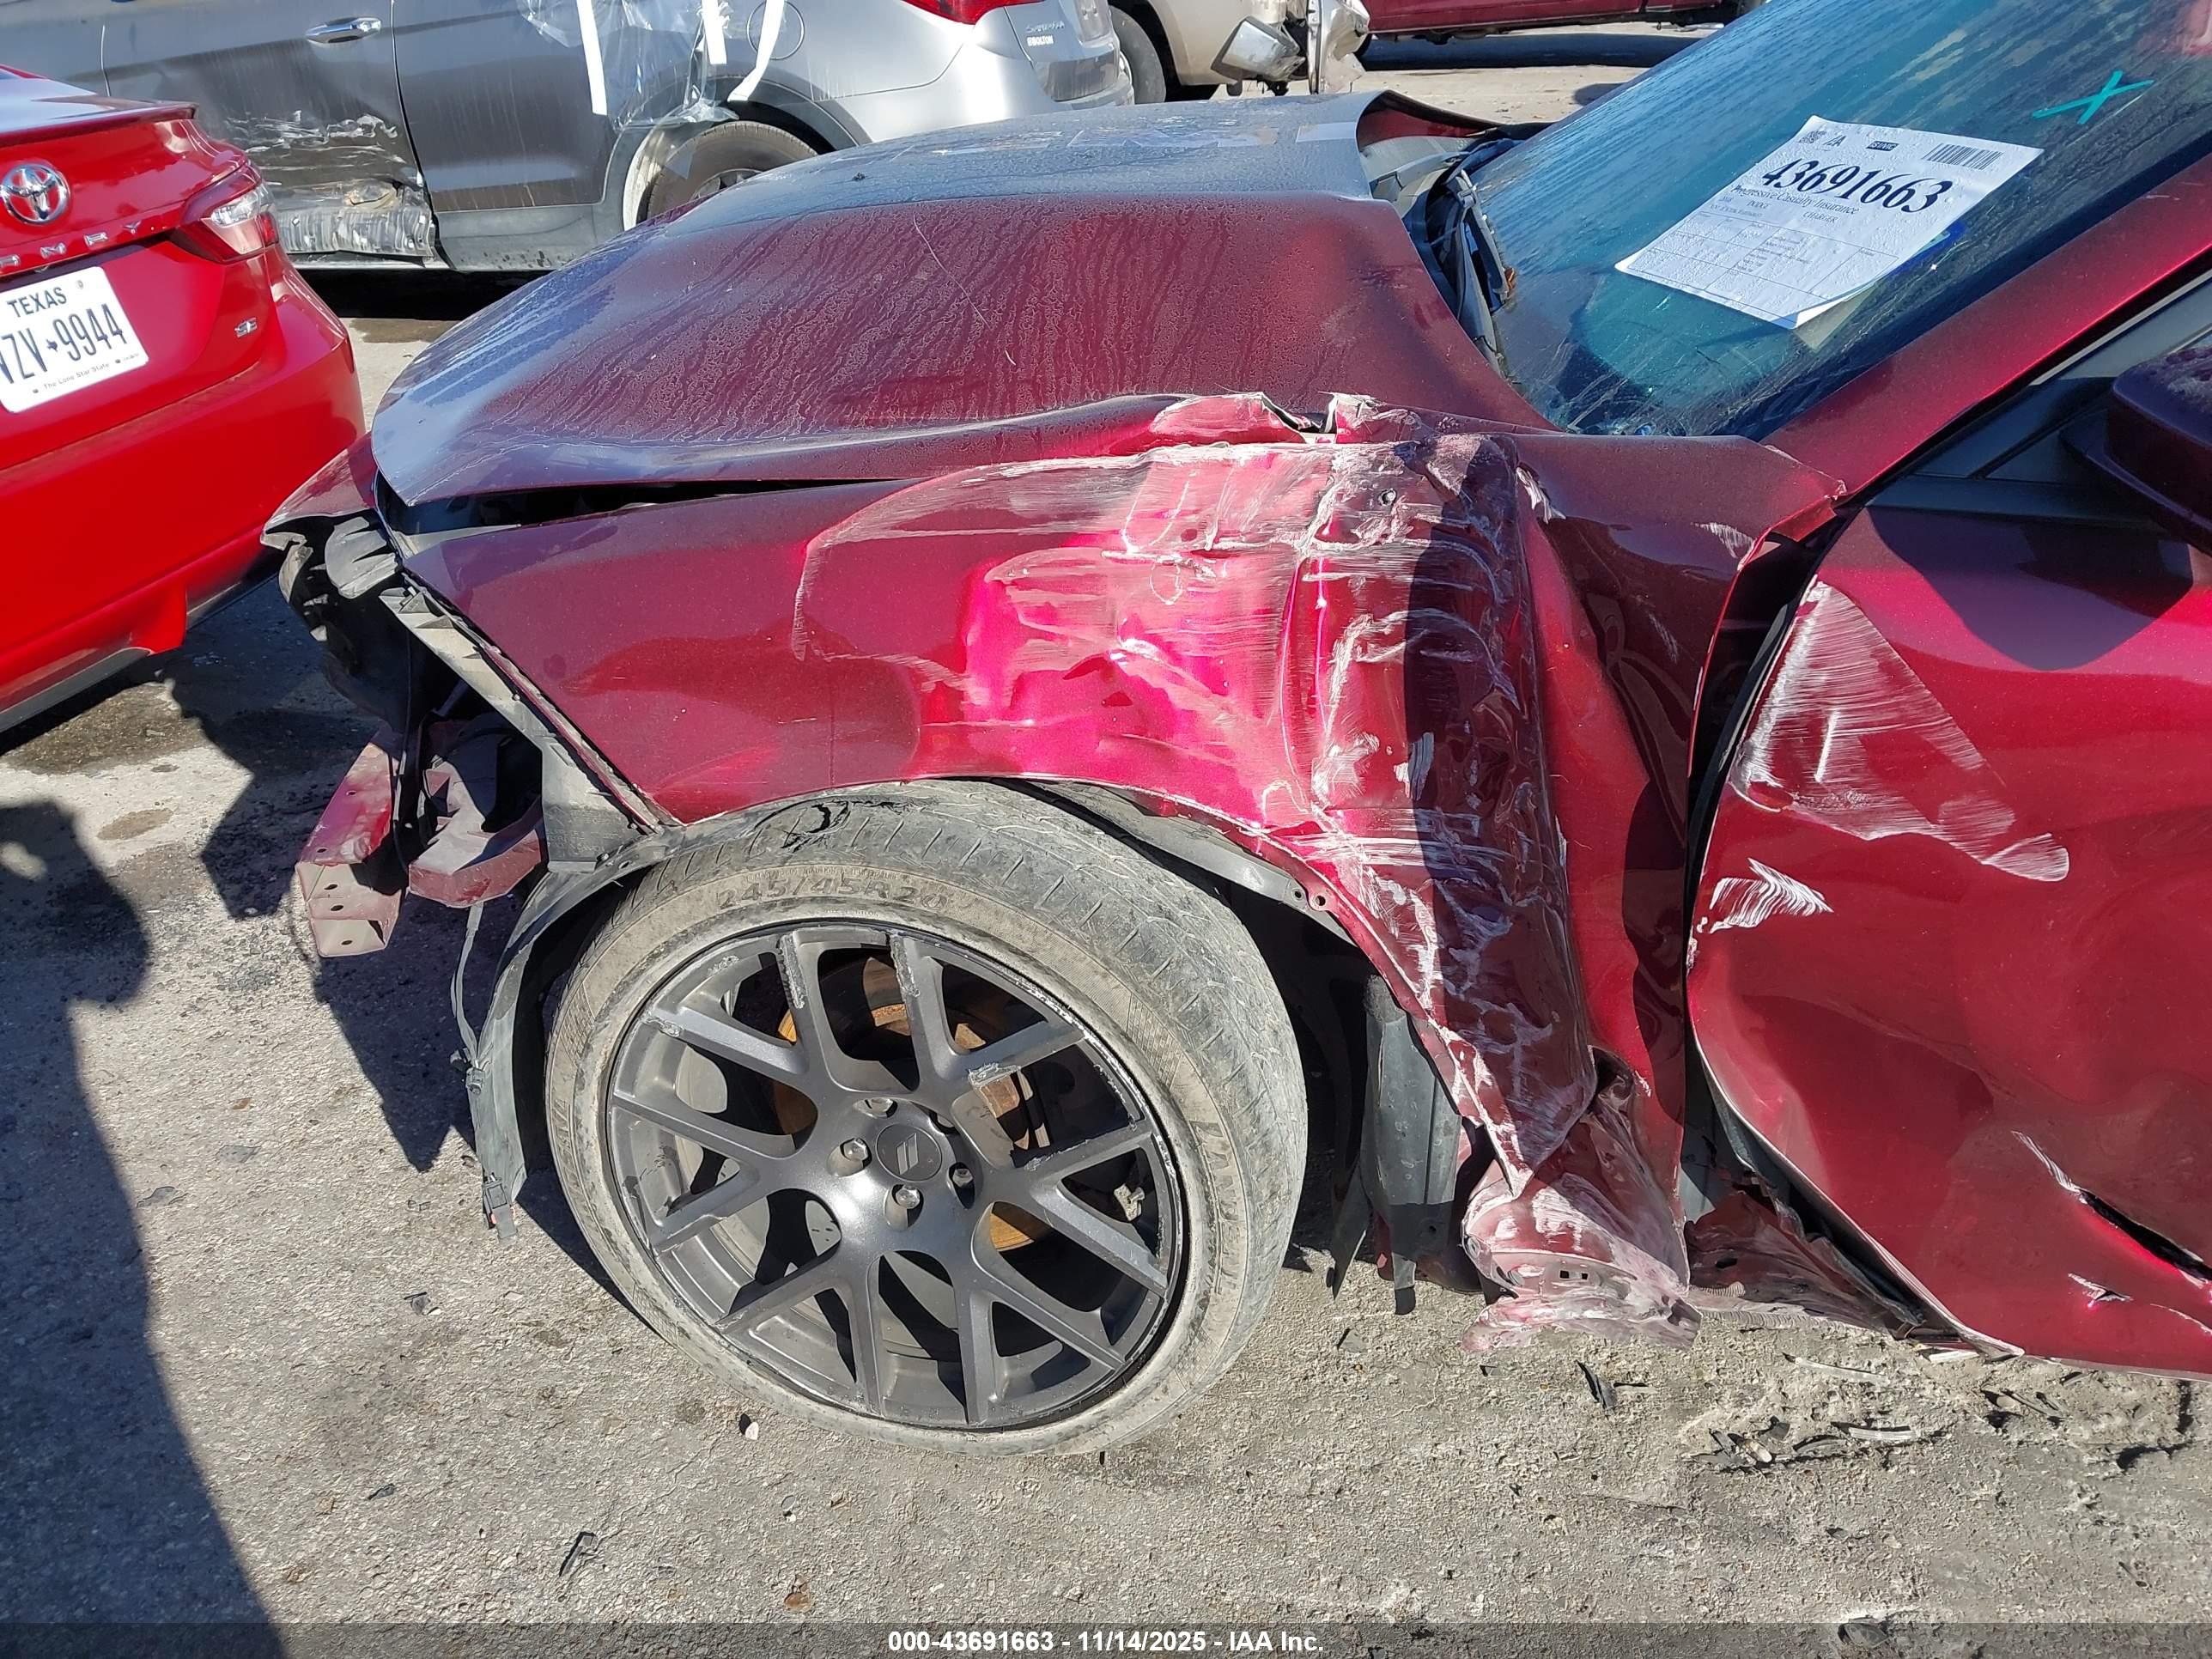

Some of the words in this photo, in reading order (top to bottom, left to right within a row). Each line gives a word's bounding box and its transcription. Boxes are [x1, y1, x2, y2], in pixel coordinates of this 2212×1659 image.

[1730, 184, 1777, 199] Progressive
[1777, 191, 1814, 207] Casualty
[1814, 198, 1861, 215] Insurance
[1761, 158, 1954, 213] 43691663
[1802, 210, 1839, 223] CHARGER
[7, 286, 68, 318] TEXAS
[52, 303, 128, 362] 9944
[234, 317, 258, 337] SE
[76, 369, 90, 378] Star
[91, 362, 110, 373] State
